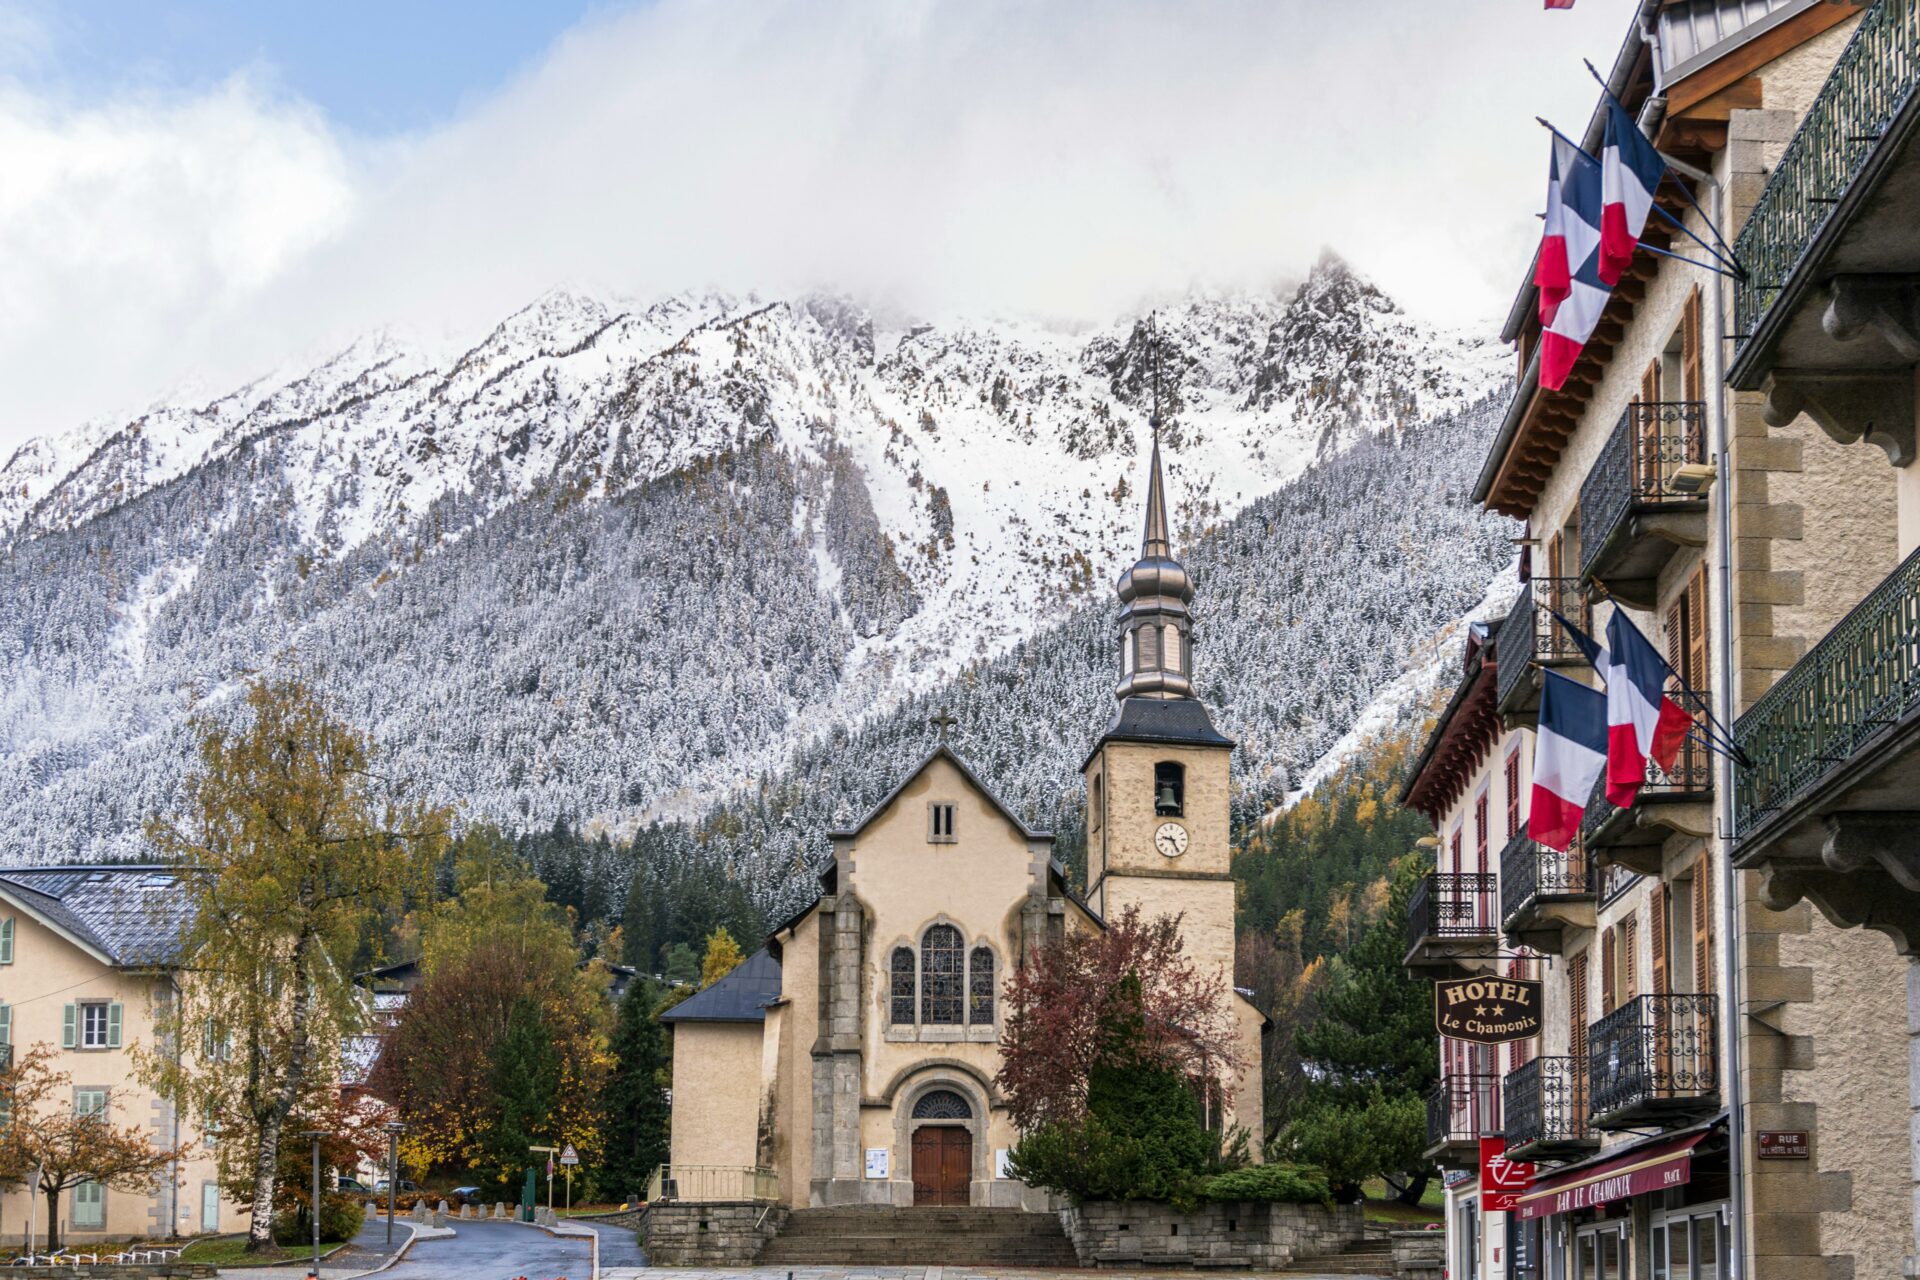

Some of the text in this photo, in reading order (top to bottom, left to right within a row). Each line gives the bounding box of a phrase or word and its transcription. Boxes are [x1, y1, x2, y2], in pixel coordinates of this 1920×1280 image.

[1444, 982, 1530, 1006] HOTEL
[1442, 1013, 1537, 1035] Le Chamonix
[1778, 1135, 1799, 1144] RUE
[1556, 1174, 1632, 1212] BAR LE CHAMONIX
